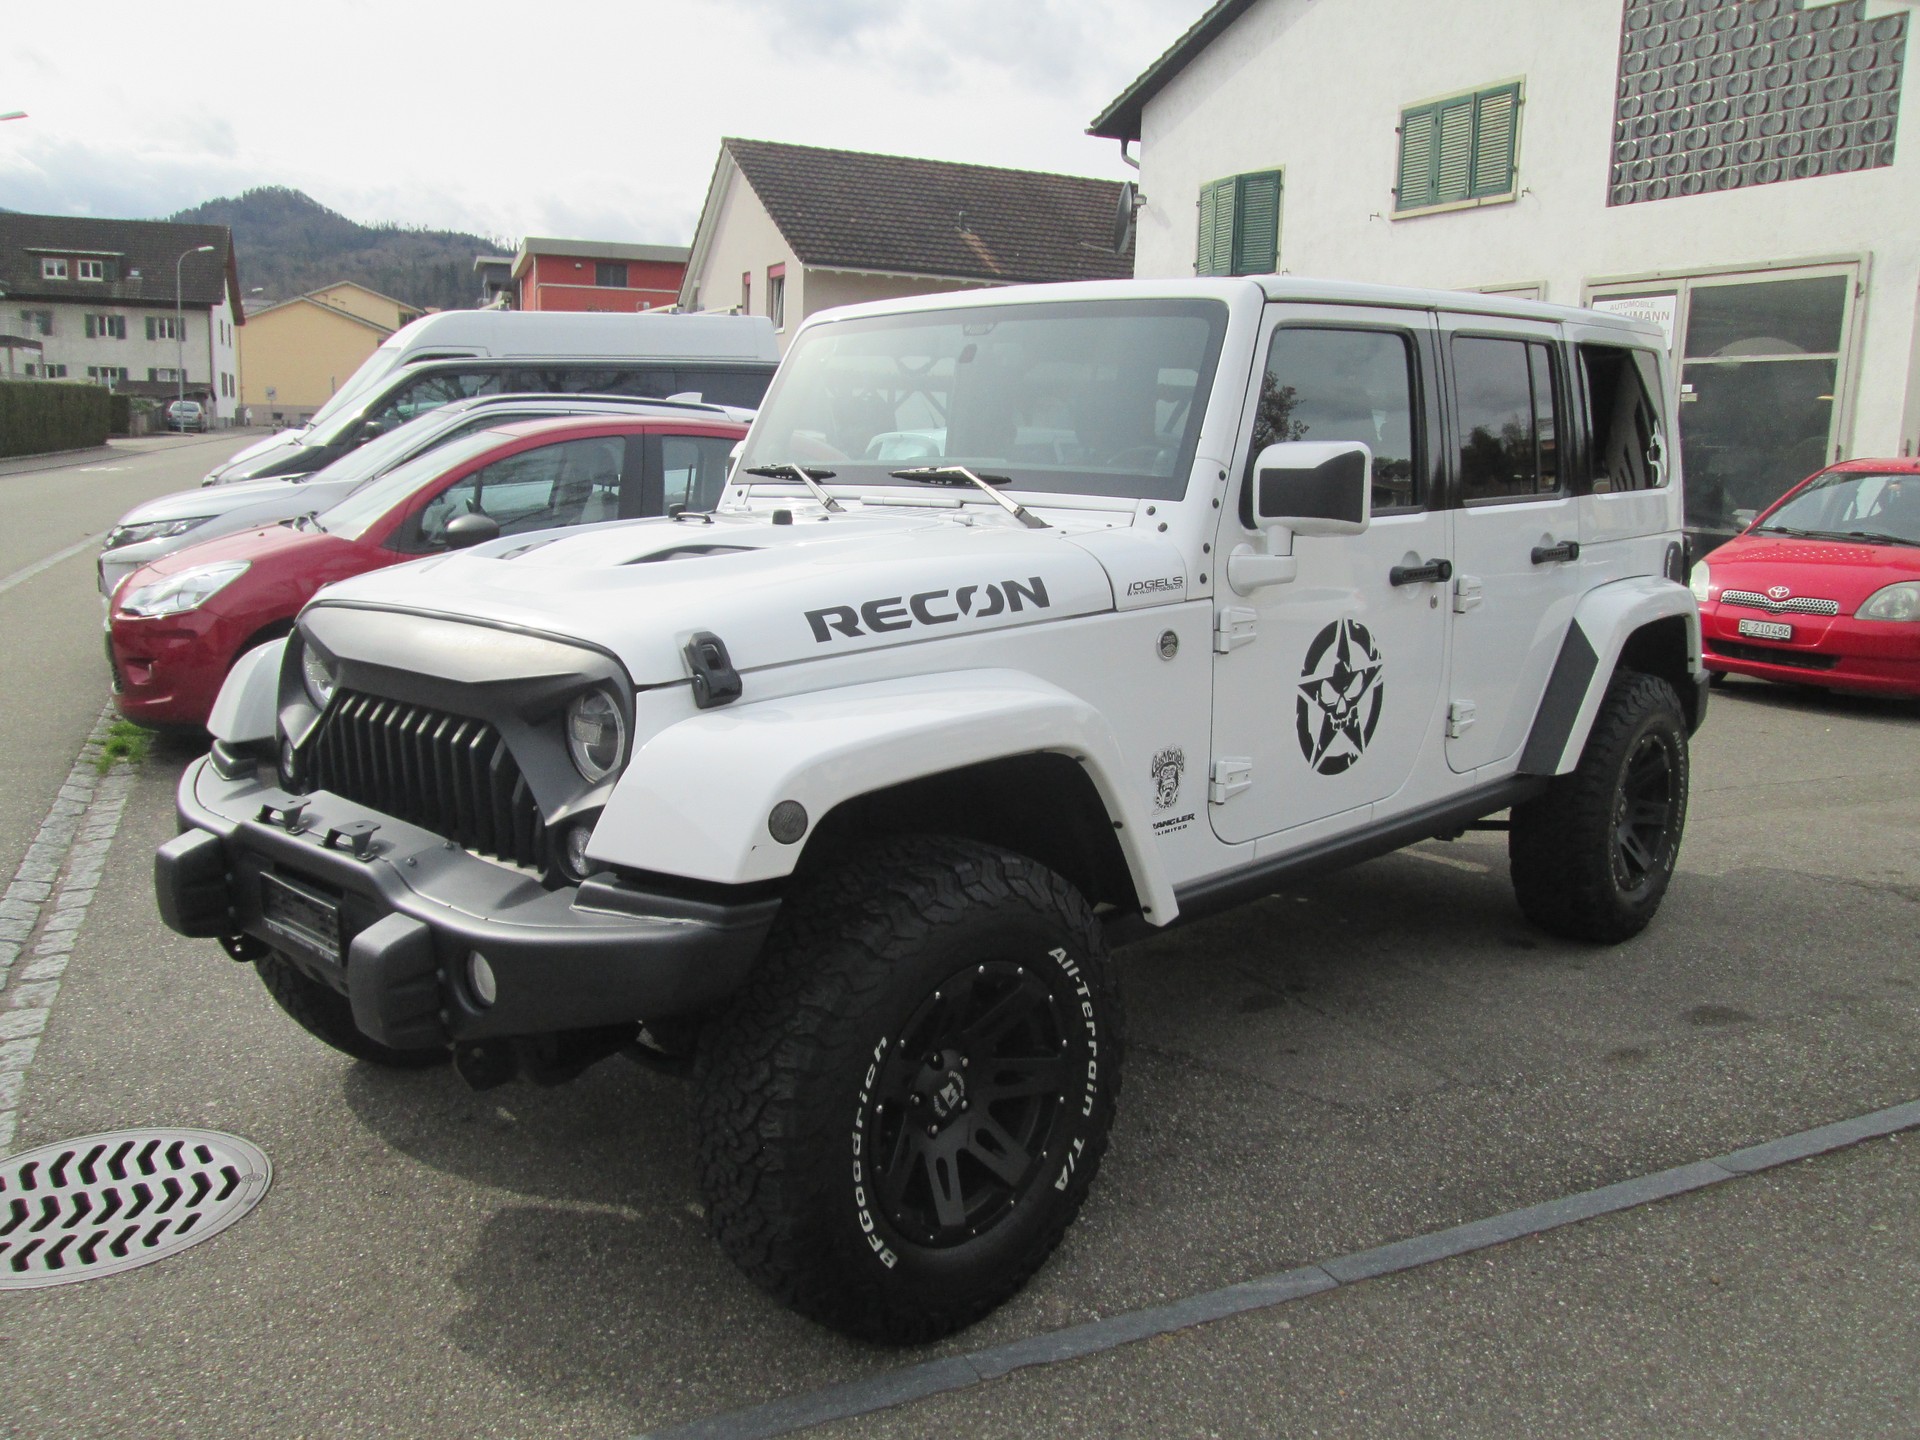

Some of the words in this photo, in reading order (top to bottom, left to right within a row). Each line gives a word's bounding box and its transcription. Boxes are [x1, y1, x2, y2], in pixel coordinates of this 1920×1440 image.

[1609, 300, 1656, 311] AUTOMOBILE
[804, 576, 1051, 643] RECON
[1048, 947, 1097, 1117] All-Terrain
[852, 1036, 898, 1269] BFGoodrich
[1054, 1137, 1085, 1191] T/A
